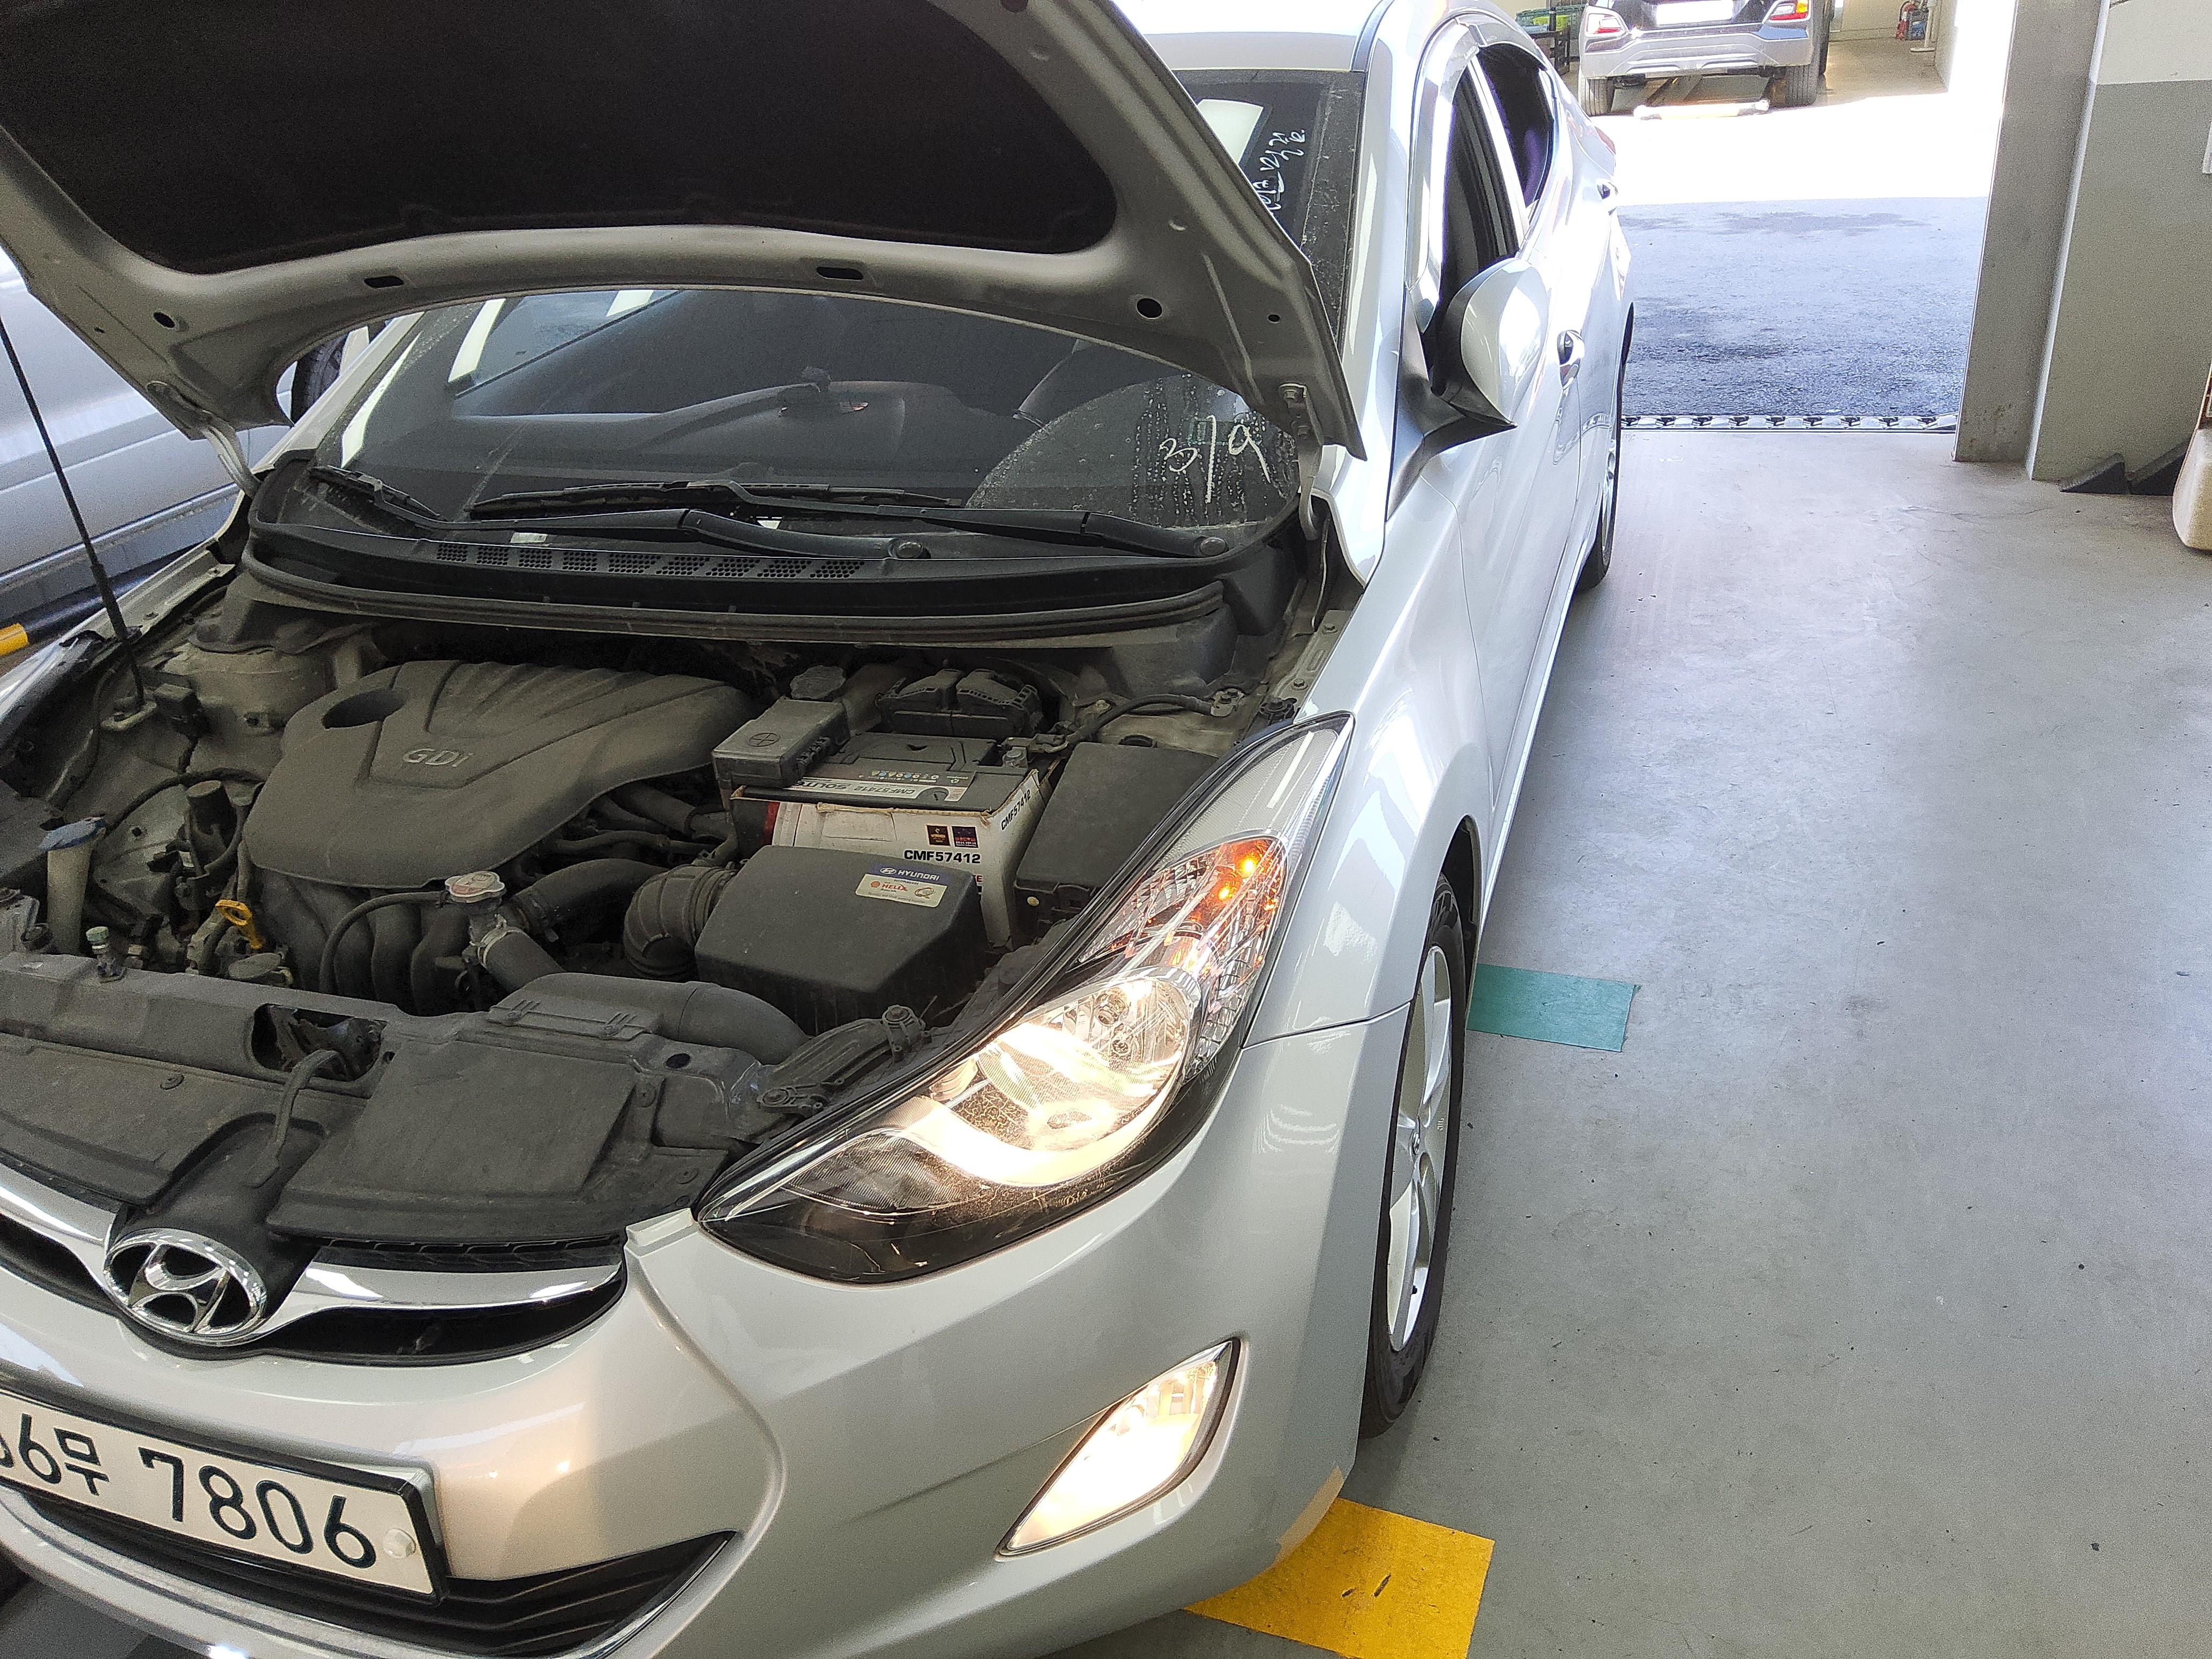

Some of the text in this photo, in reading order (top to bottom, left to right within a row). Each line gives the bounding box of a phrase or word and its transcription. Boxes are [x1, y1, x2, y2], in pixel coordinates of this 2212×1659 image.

[854, 786, 916, 795] CMF57412
[1001, 789, 1031, 831] CMF57412
[904, 850, 981, 864] CMF57412
[898, 870, 940, 881] HYUNDAI
[881, 884, 908, 892] HELIX
[138, 1446, 377, 1569] 7806
